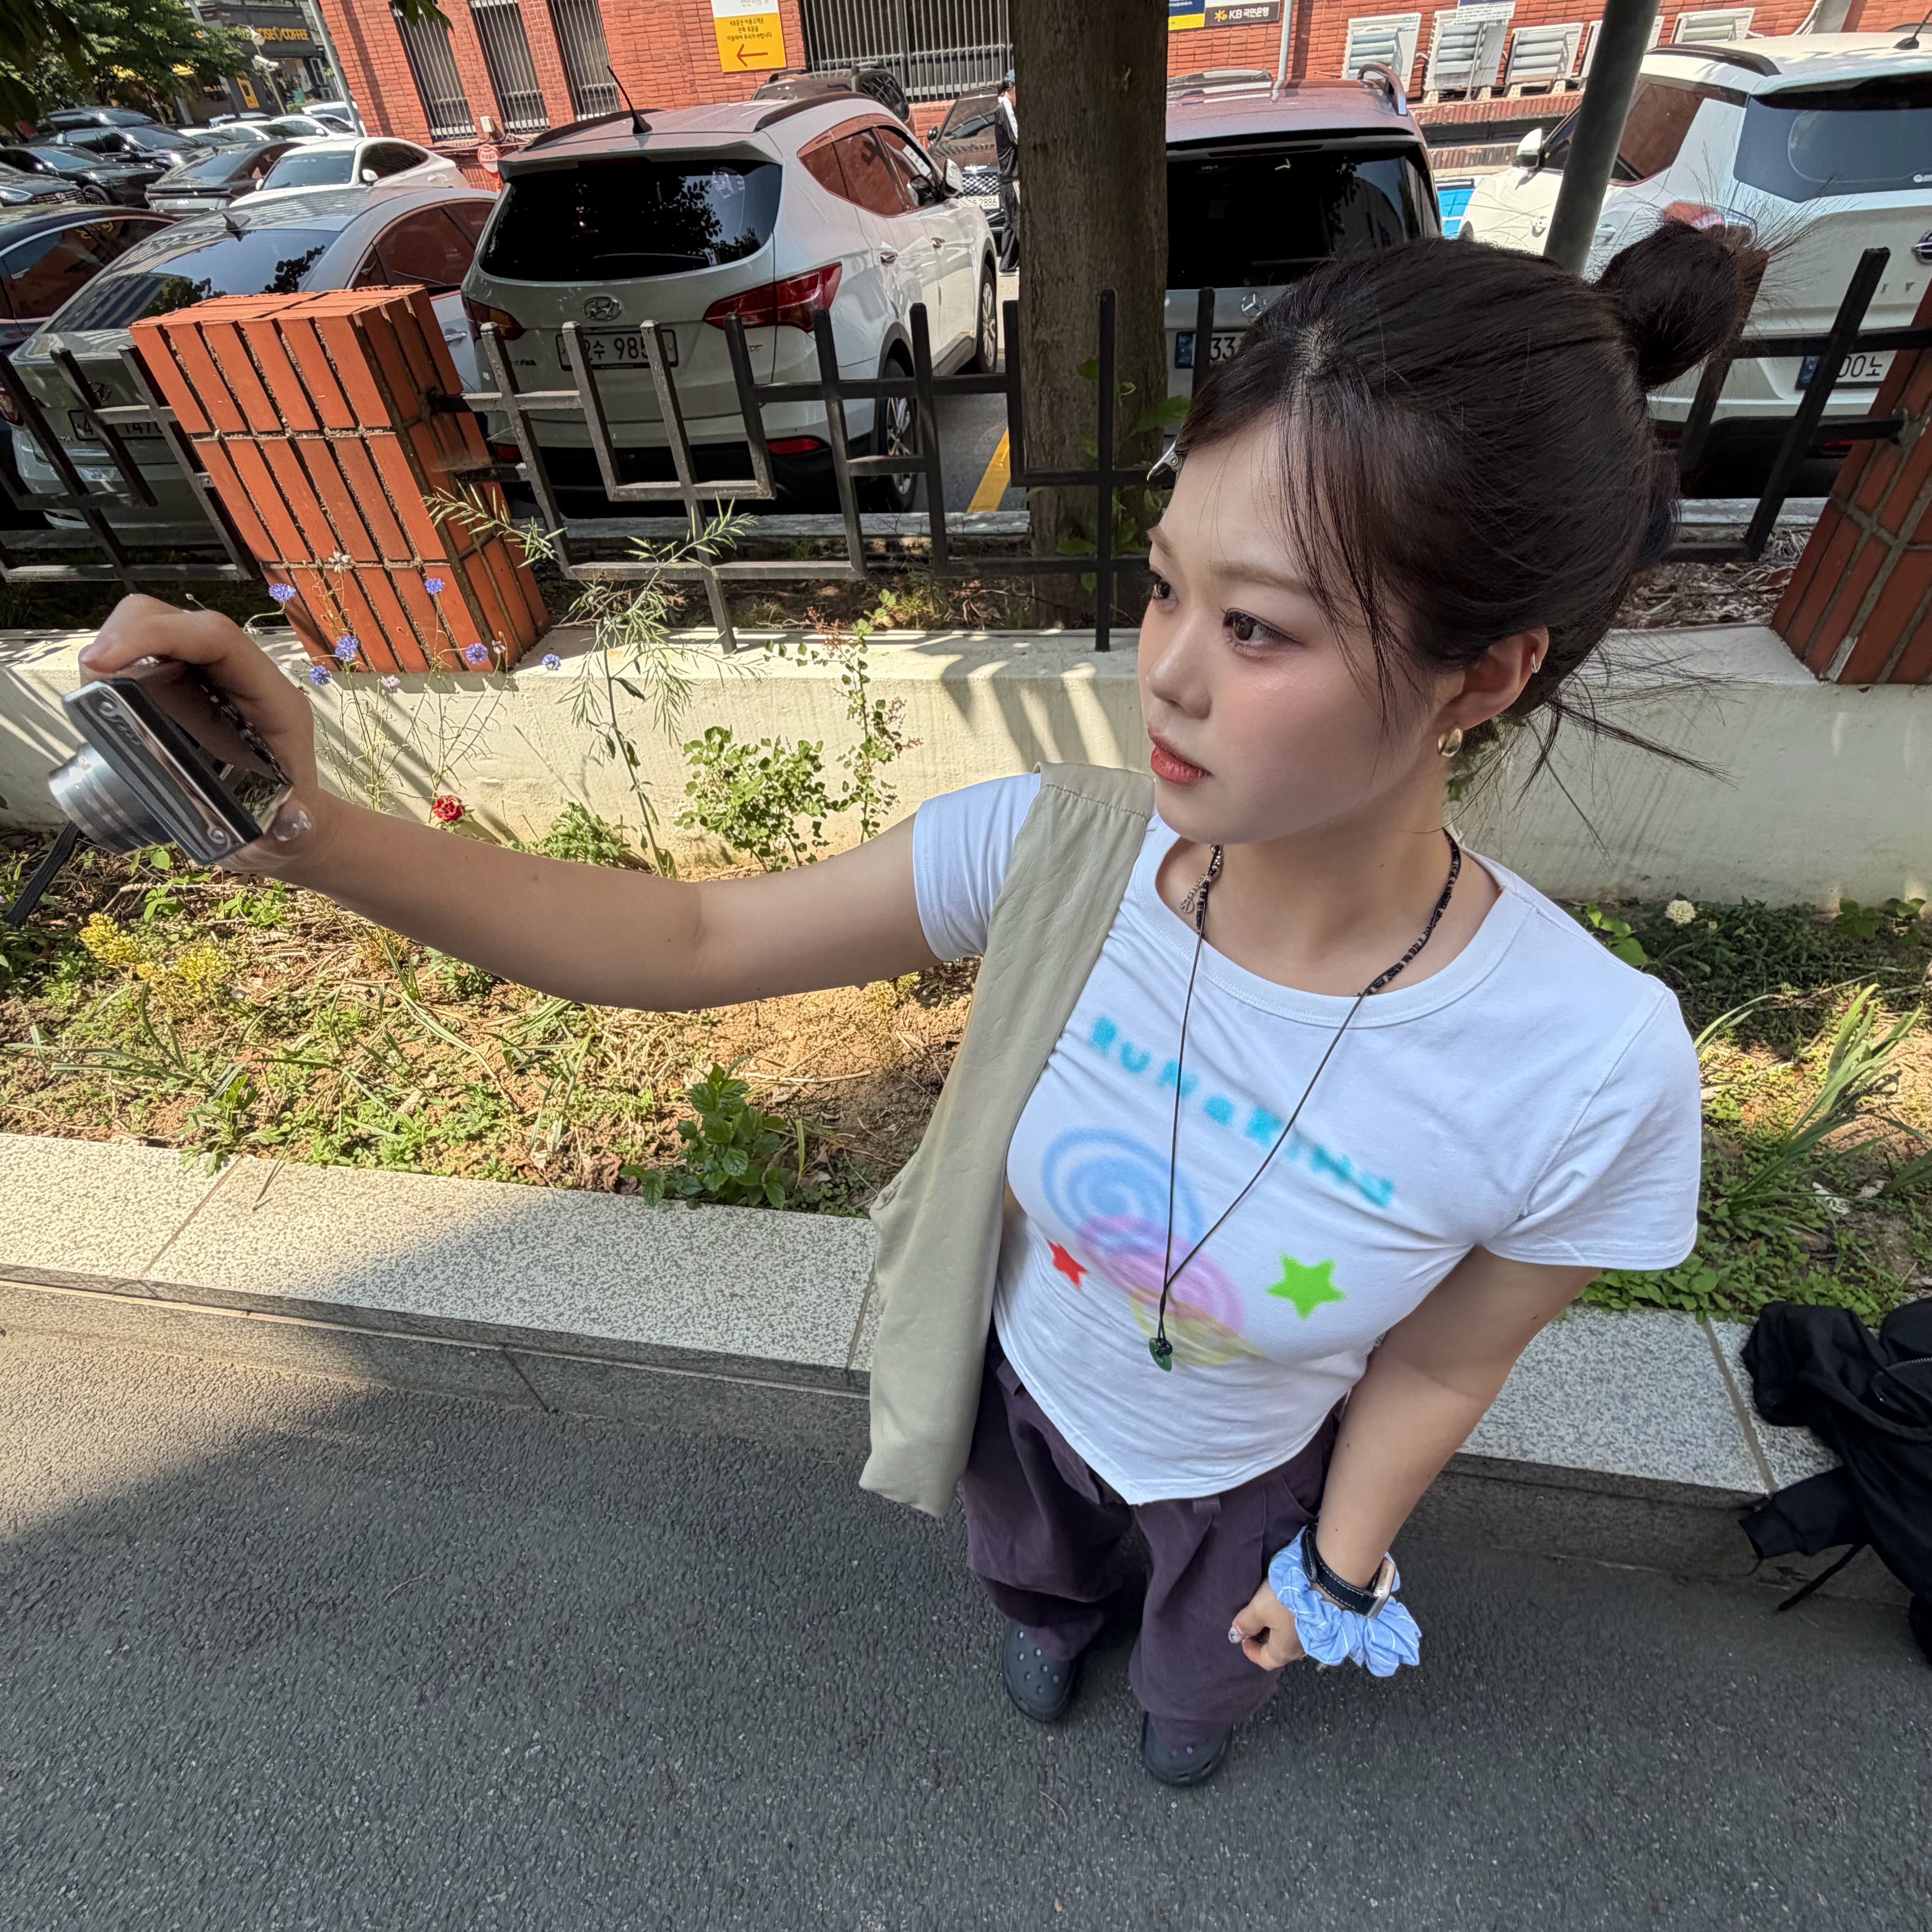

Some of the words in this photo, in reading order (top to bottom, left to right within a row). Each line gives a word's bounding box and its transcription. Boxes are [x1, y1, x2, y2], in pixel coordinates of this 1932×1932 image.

[1229, 7, 1270, 19] KB국민은행
[281, 28, 310, 41] COFFEE
[1211, 337, 1236, 360] 33
[1838, 355, 1882, 378] 00노
